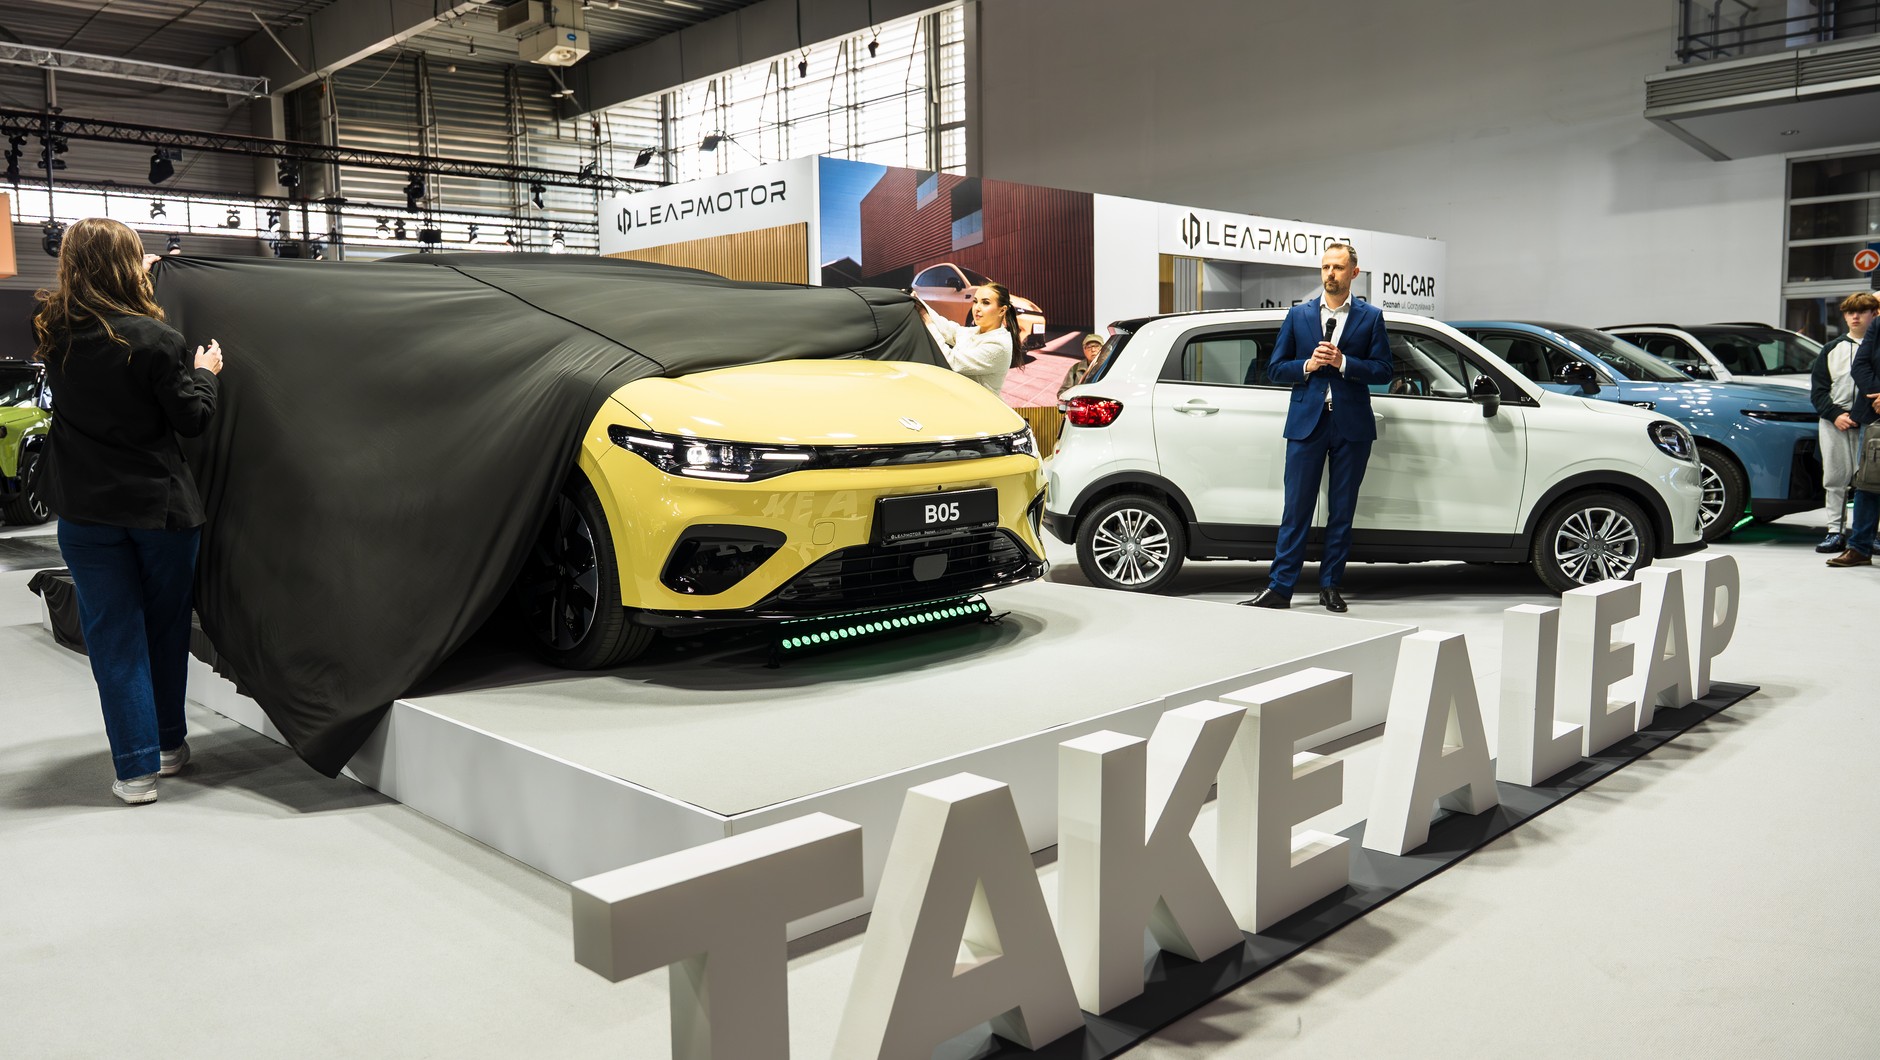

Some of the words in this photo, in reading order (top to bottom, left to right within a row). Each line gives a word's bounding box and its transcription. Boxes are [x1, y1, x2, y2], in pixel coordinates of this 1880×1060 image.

[636, 180, 786, 228] LEAPMOTOR
[1206, 221, 1351, 256] LEAPMOTO
[1383, 272, 1435, 297] POL-CAR
[925, 502, 960, 524] B05
[573, 668, 1353, 1060] TAKE
[1362, 630, 1500, 856] A
[1496, 553, 1740, 787] LEAP
